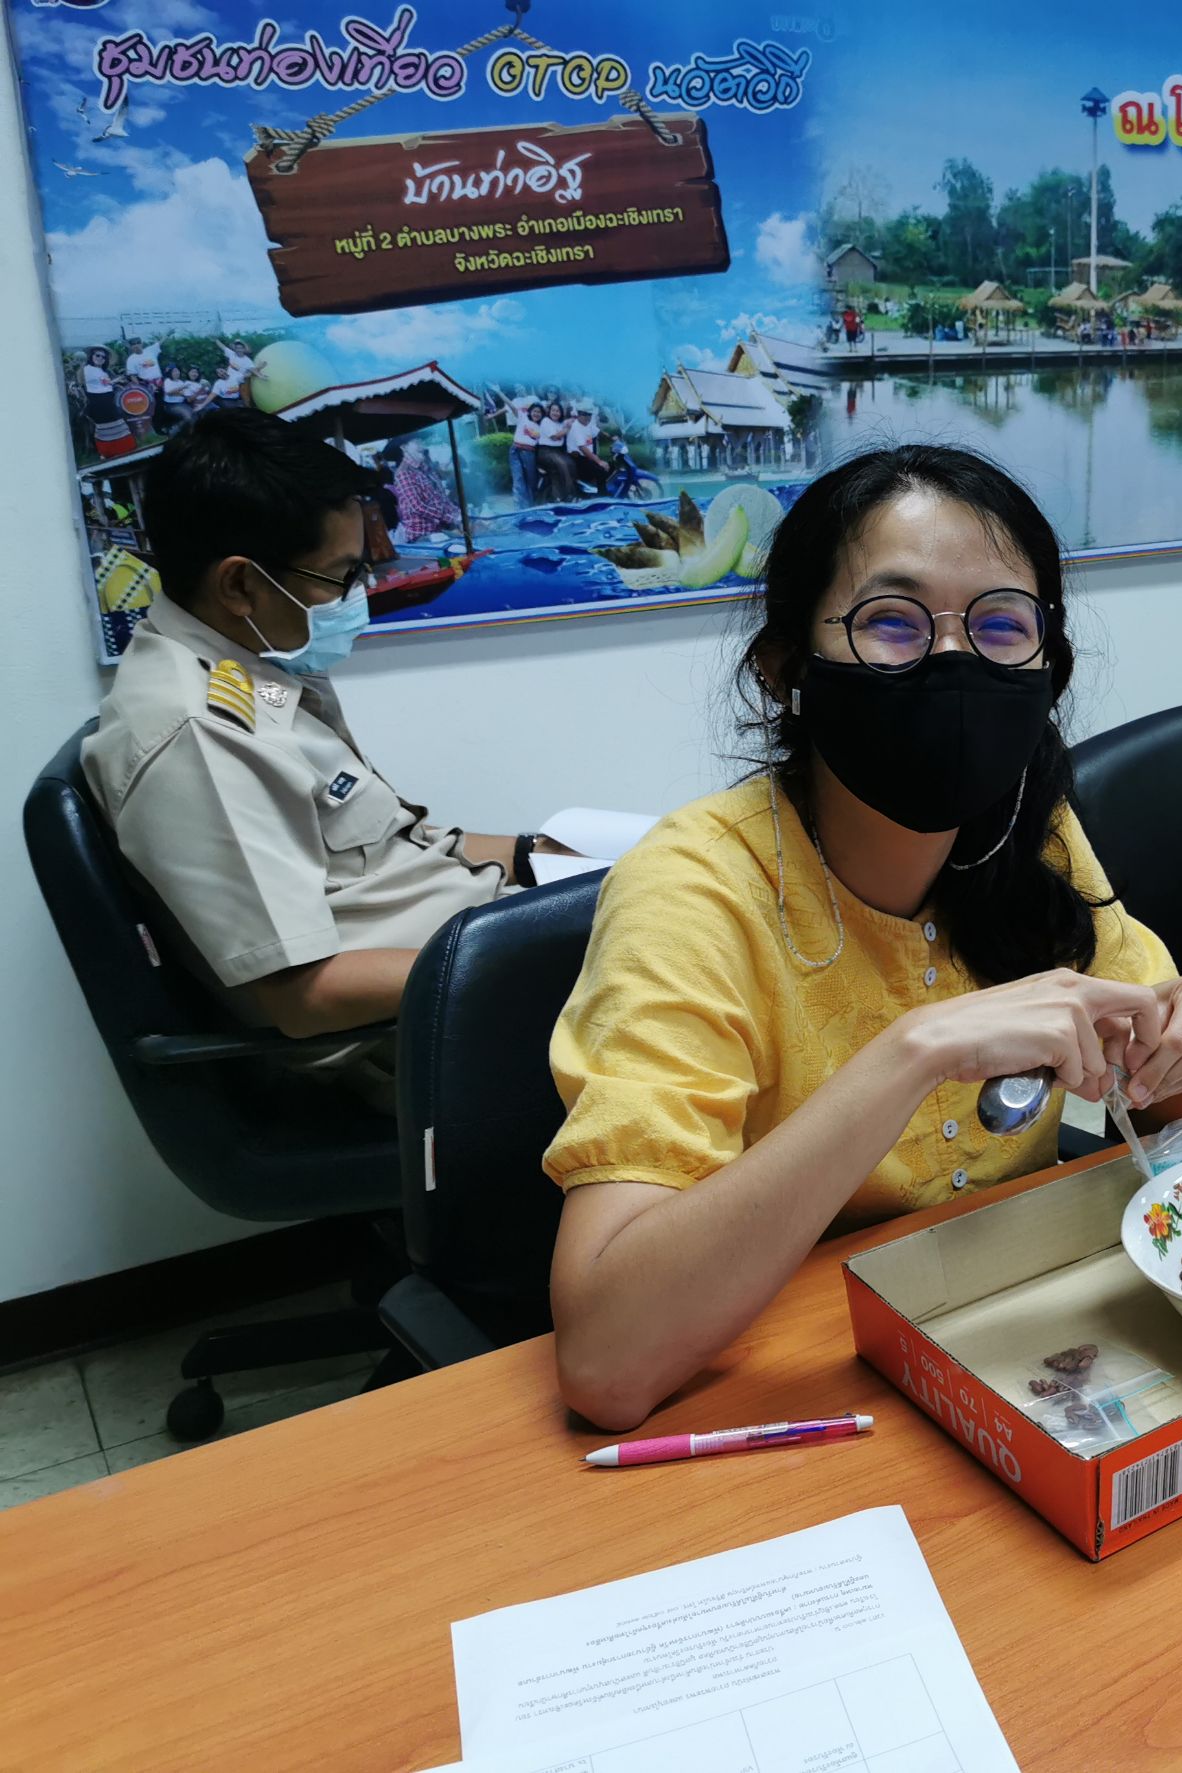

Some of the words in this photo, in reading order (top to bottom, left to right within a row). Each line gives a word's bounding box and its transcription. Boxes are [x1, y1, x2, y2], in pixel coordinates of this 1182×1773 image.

[98, 6, 465, 111] ชุมชนท่องเที่ยว
[490, 50, 630, 100] OTOP
[650, 41, 809, 112] นวัตวิถี
[1119, 96, 1160, 137] ณ
[404, 141, 593, 204] บ้านท่าอิฐ
[334, 224, 377, 260] หมู่ที่
[381, 231, 393, 250] 2
[399, 221, 512, 248] ตำบลบางพระ
[516, 206, 684, 237] อำเภอเมืองฉะเชิงเทรา
[454, 243, 595, 273] จังหวัดฉะเชิงเทรา
[920, 1355, 945, 1386] 500
[960, 1388, 978, 1414] 70
[901, 1361, 1022, 1483] QUALITY
[994, 1417, 1013, 1442] A4
